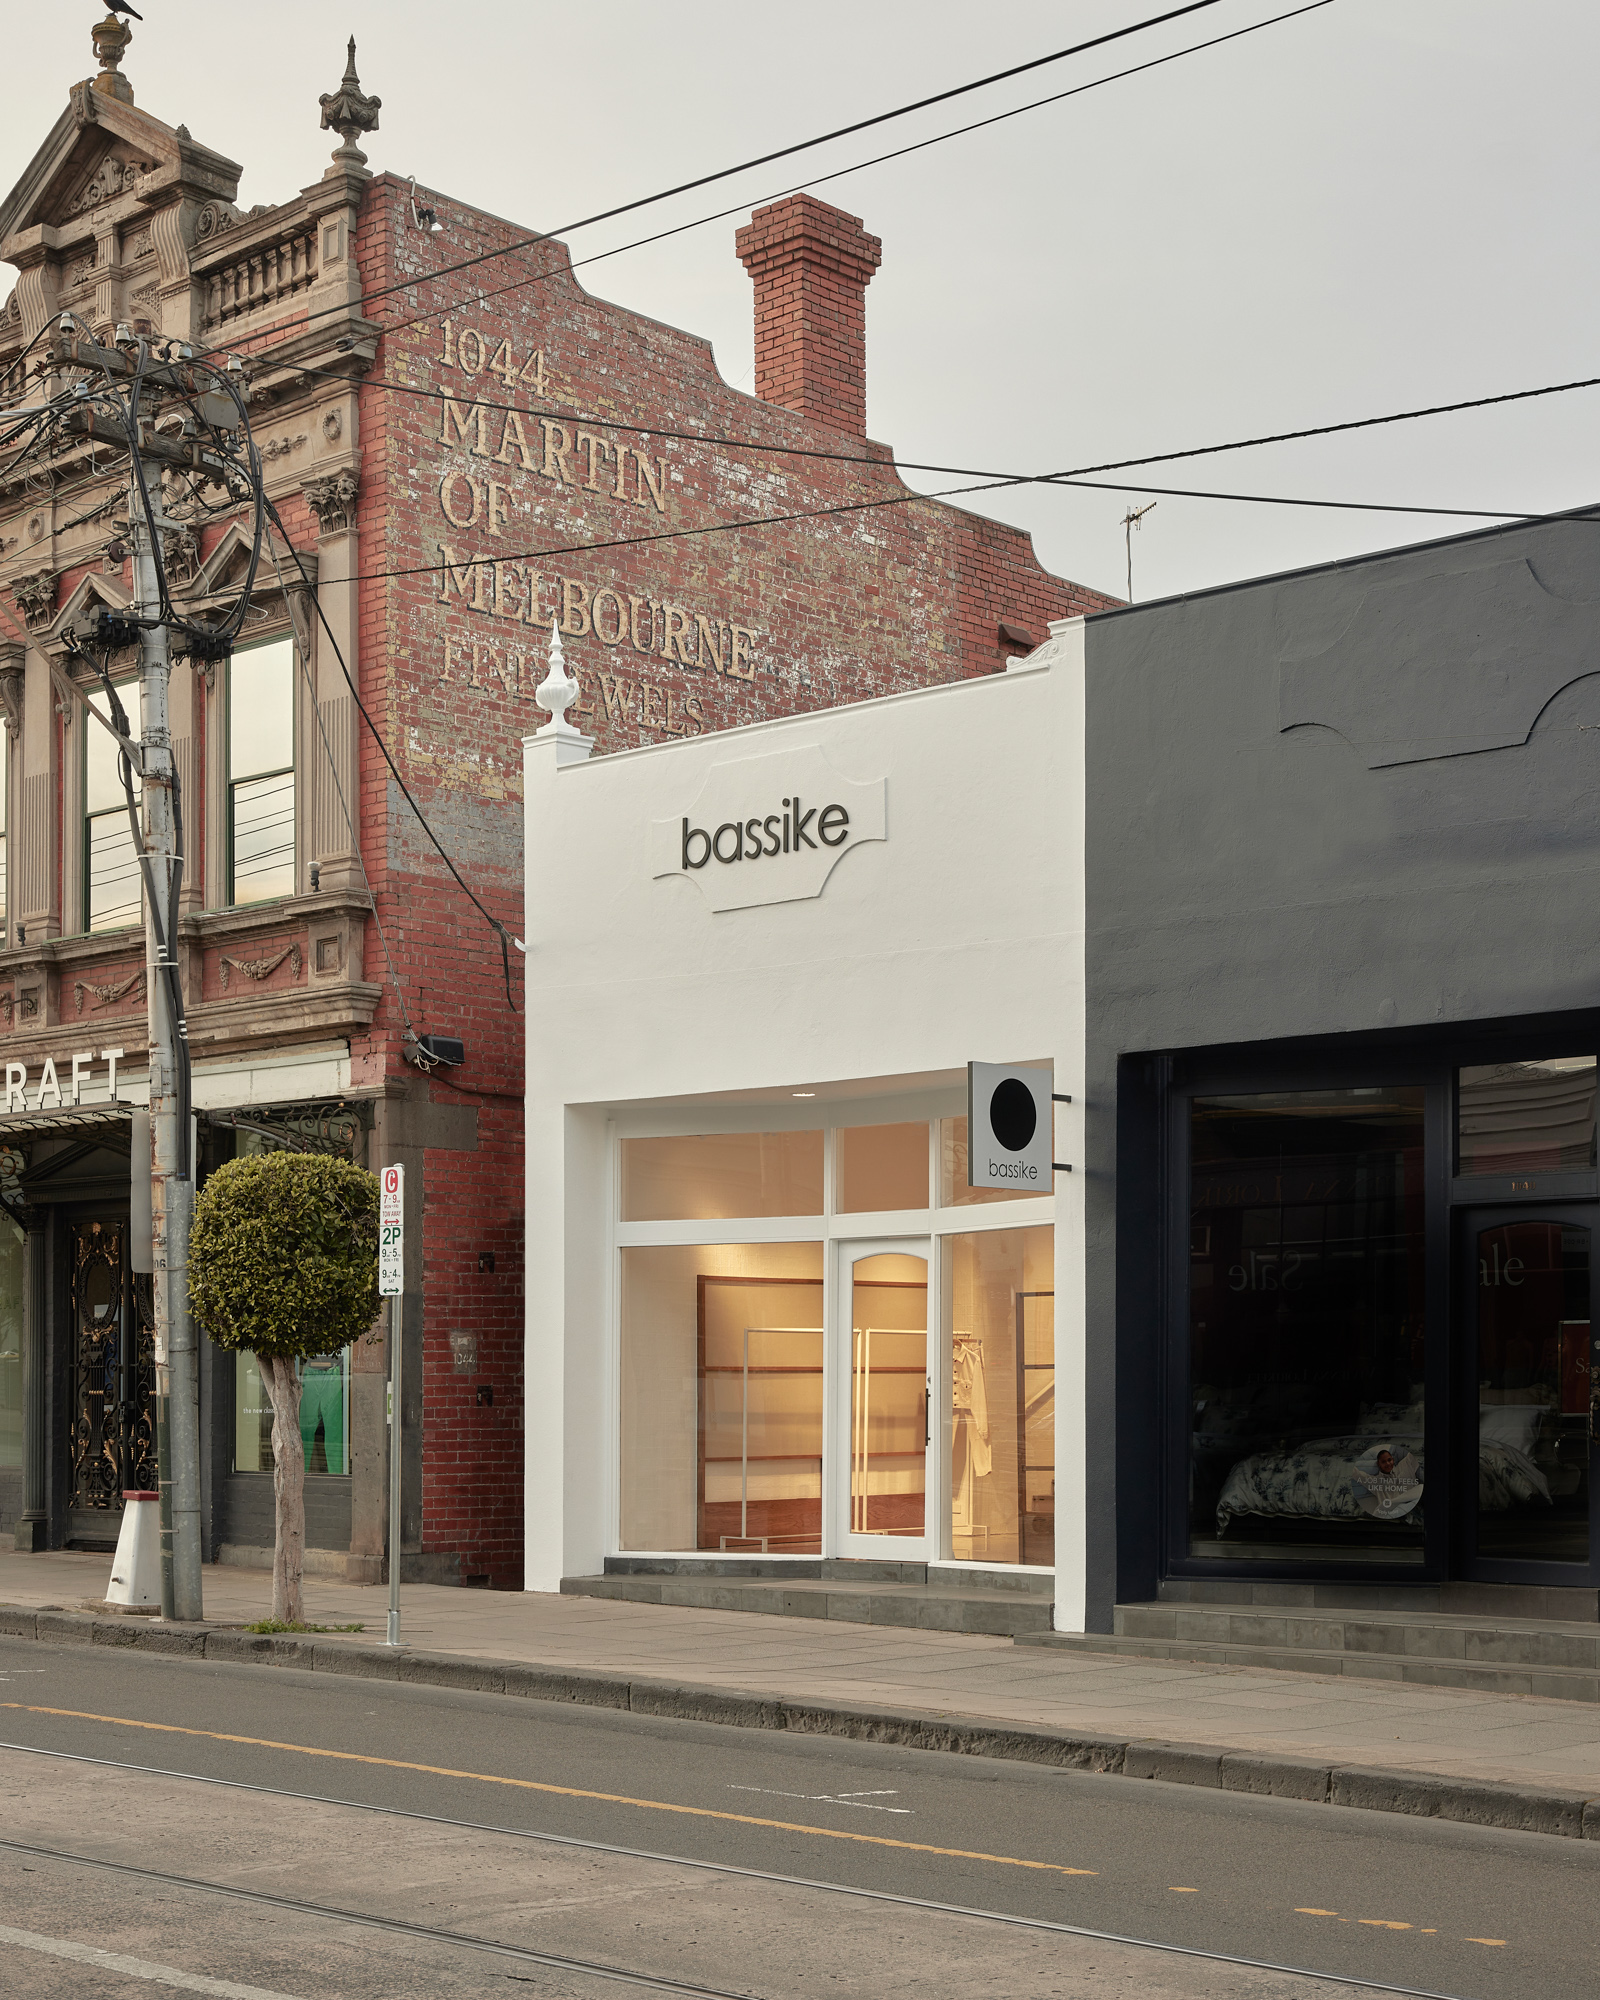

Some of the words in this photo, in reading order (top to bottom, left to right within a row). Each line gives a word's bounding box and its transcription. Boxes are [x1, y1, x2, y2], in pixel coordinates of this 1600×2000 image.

[438, 318, 551, 398] 1044
[436, 384, 670, 514] MARTIN
[438, 469, 514, 538] OF
[436, 543, 756, 682] MELBOURNE
[570, 666, 705, 736] EWELS
[681, 796, 849, 870] bassike
[5, 1048, 125, 1107] RAFT
[387, 1170, 397, 1192] C
[988, 1158, 1038, 1180] bassike
[382, 1227, 401, 1245] 2P
